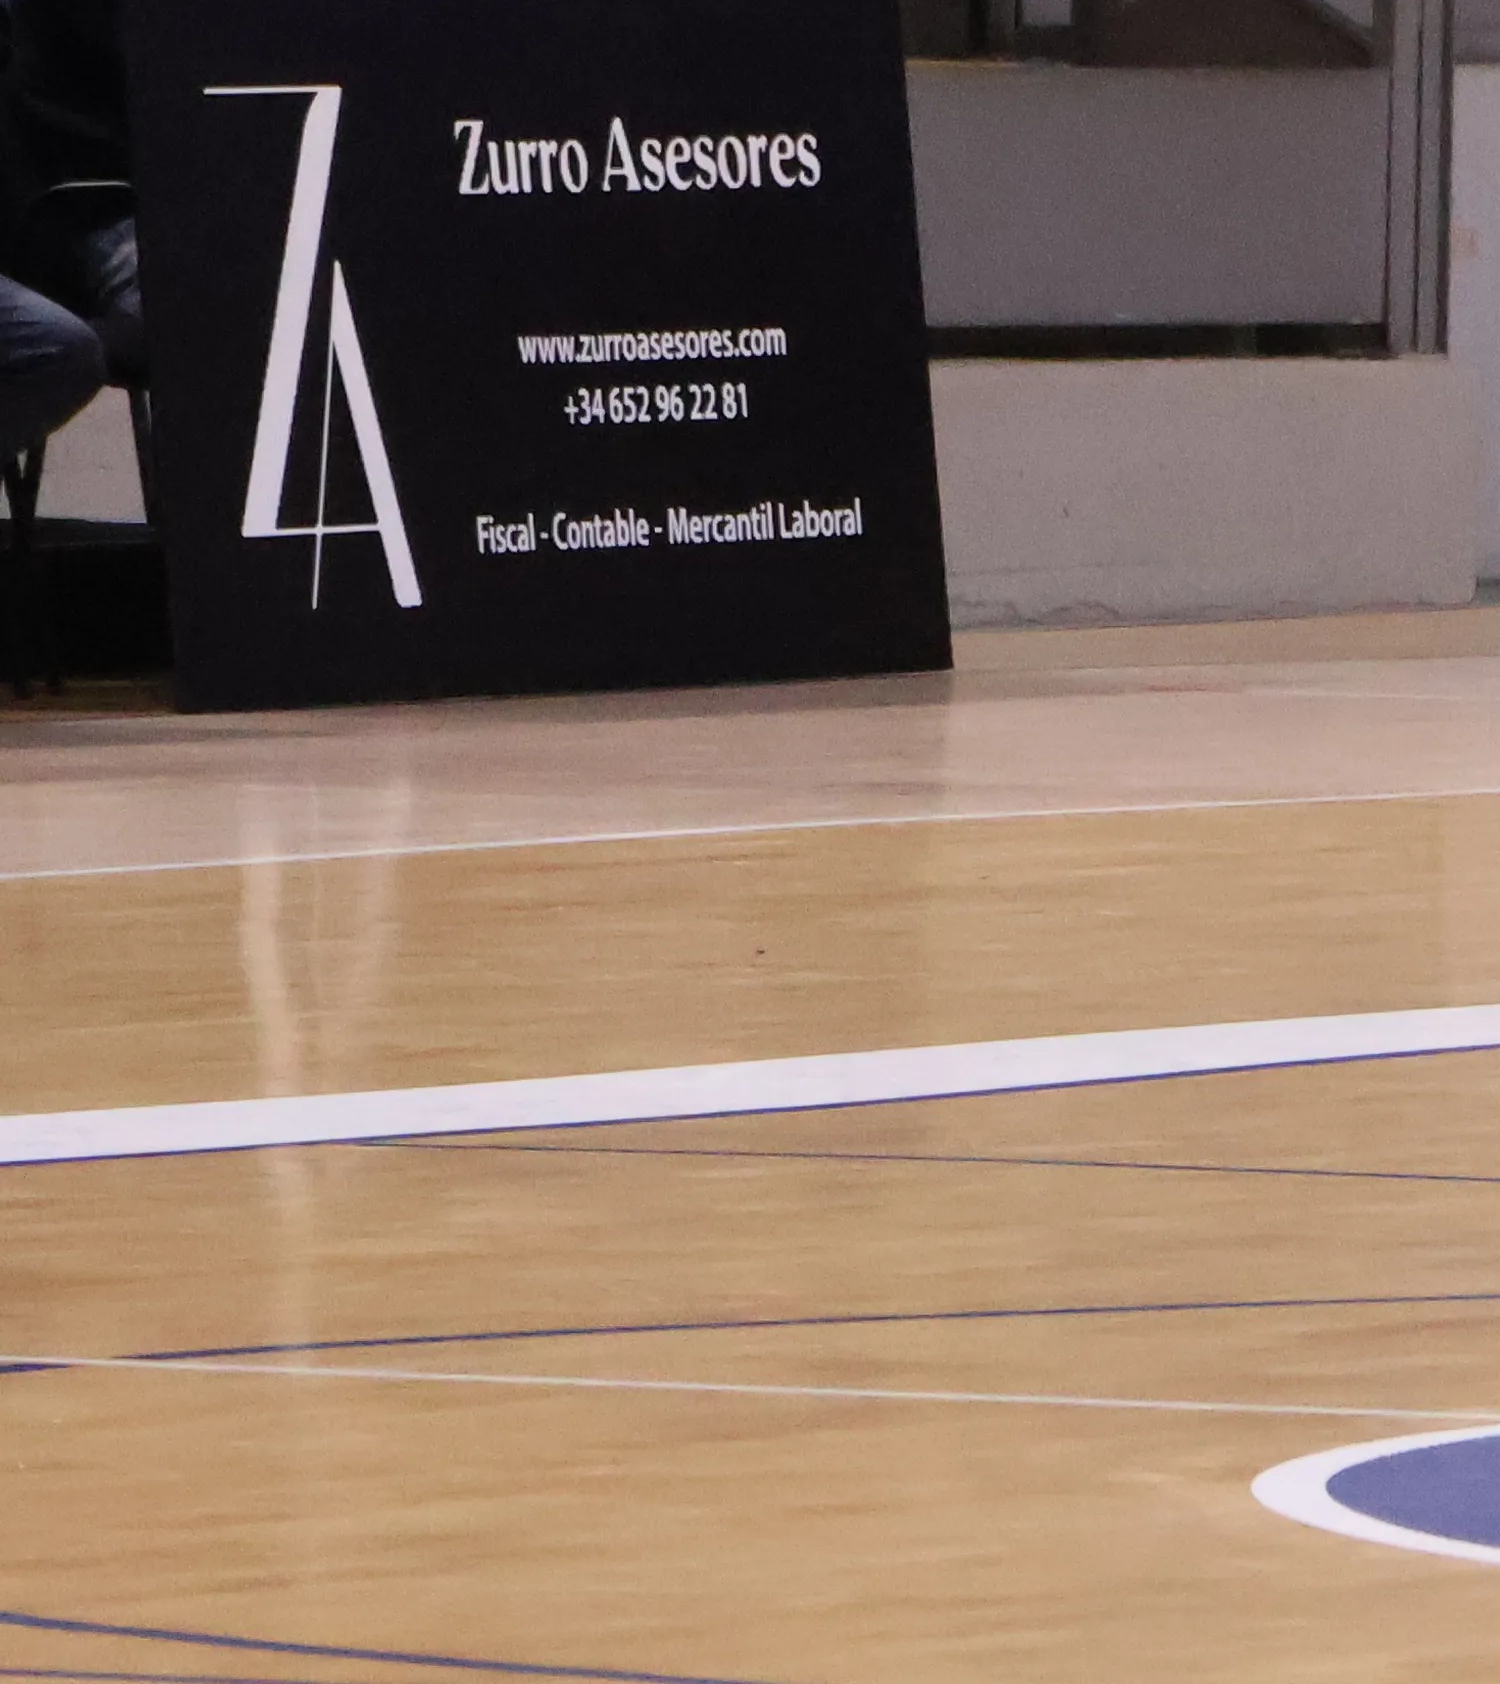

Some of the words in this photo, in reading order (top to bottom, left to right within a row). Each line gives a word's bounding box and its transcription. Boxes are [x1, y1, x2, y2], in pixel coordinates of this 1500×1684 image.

[455, 119, 588, 196] Zurro
[602, 116, 822, 192] Asesores
[518, 324, 787, 366] www.zurroasesores.com
[564, 387, 606, 426] +34
[609, 385, 650, 424] 652
[655, 384, 685, 422] 96
[689, 383, 719, 422] 22
[723, 382, 749, 420] 81
[477, 515, 537, 555] Fiscal
[552, 513, 650, 551] Contable
[668, 504, 774, 546] Mercantil
[780, 499, 863, 540] Laboral
